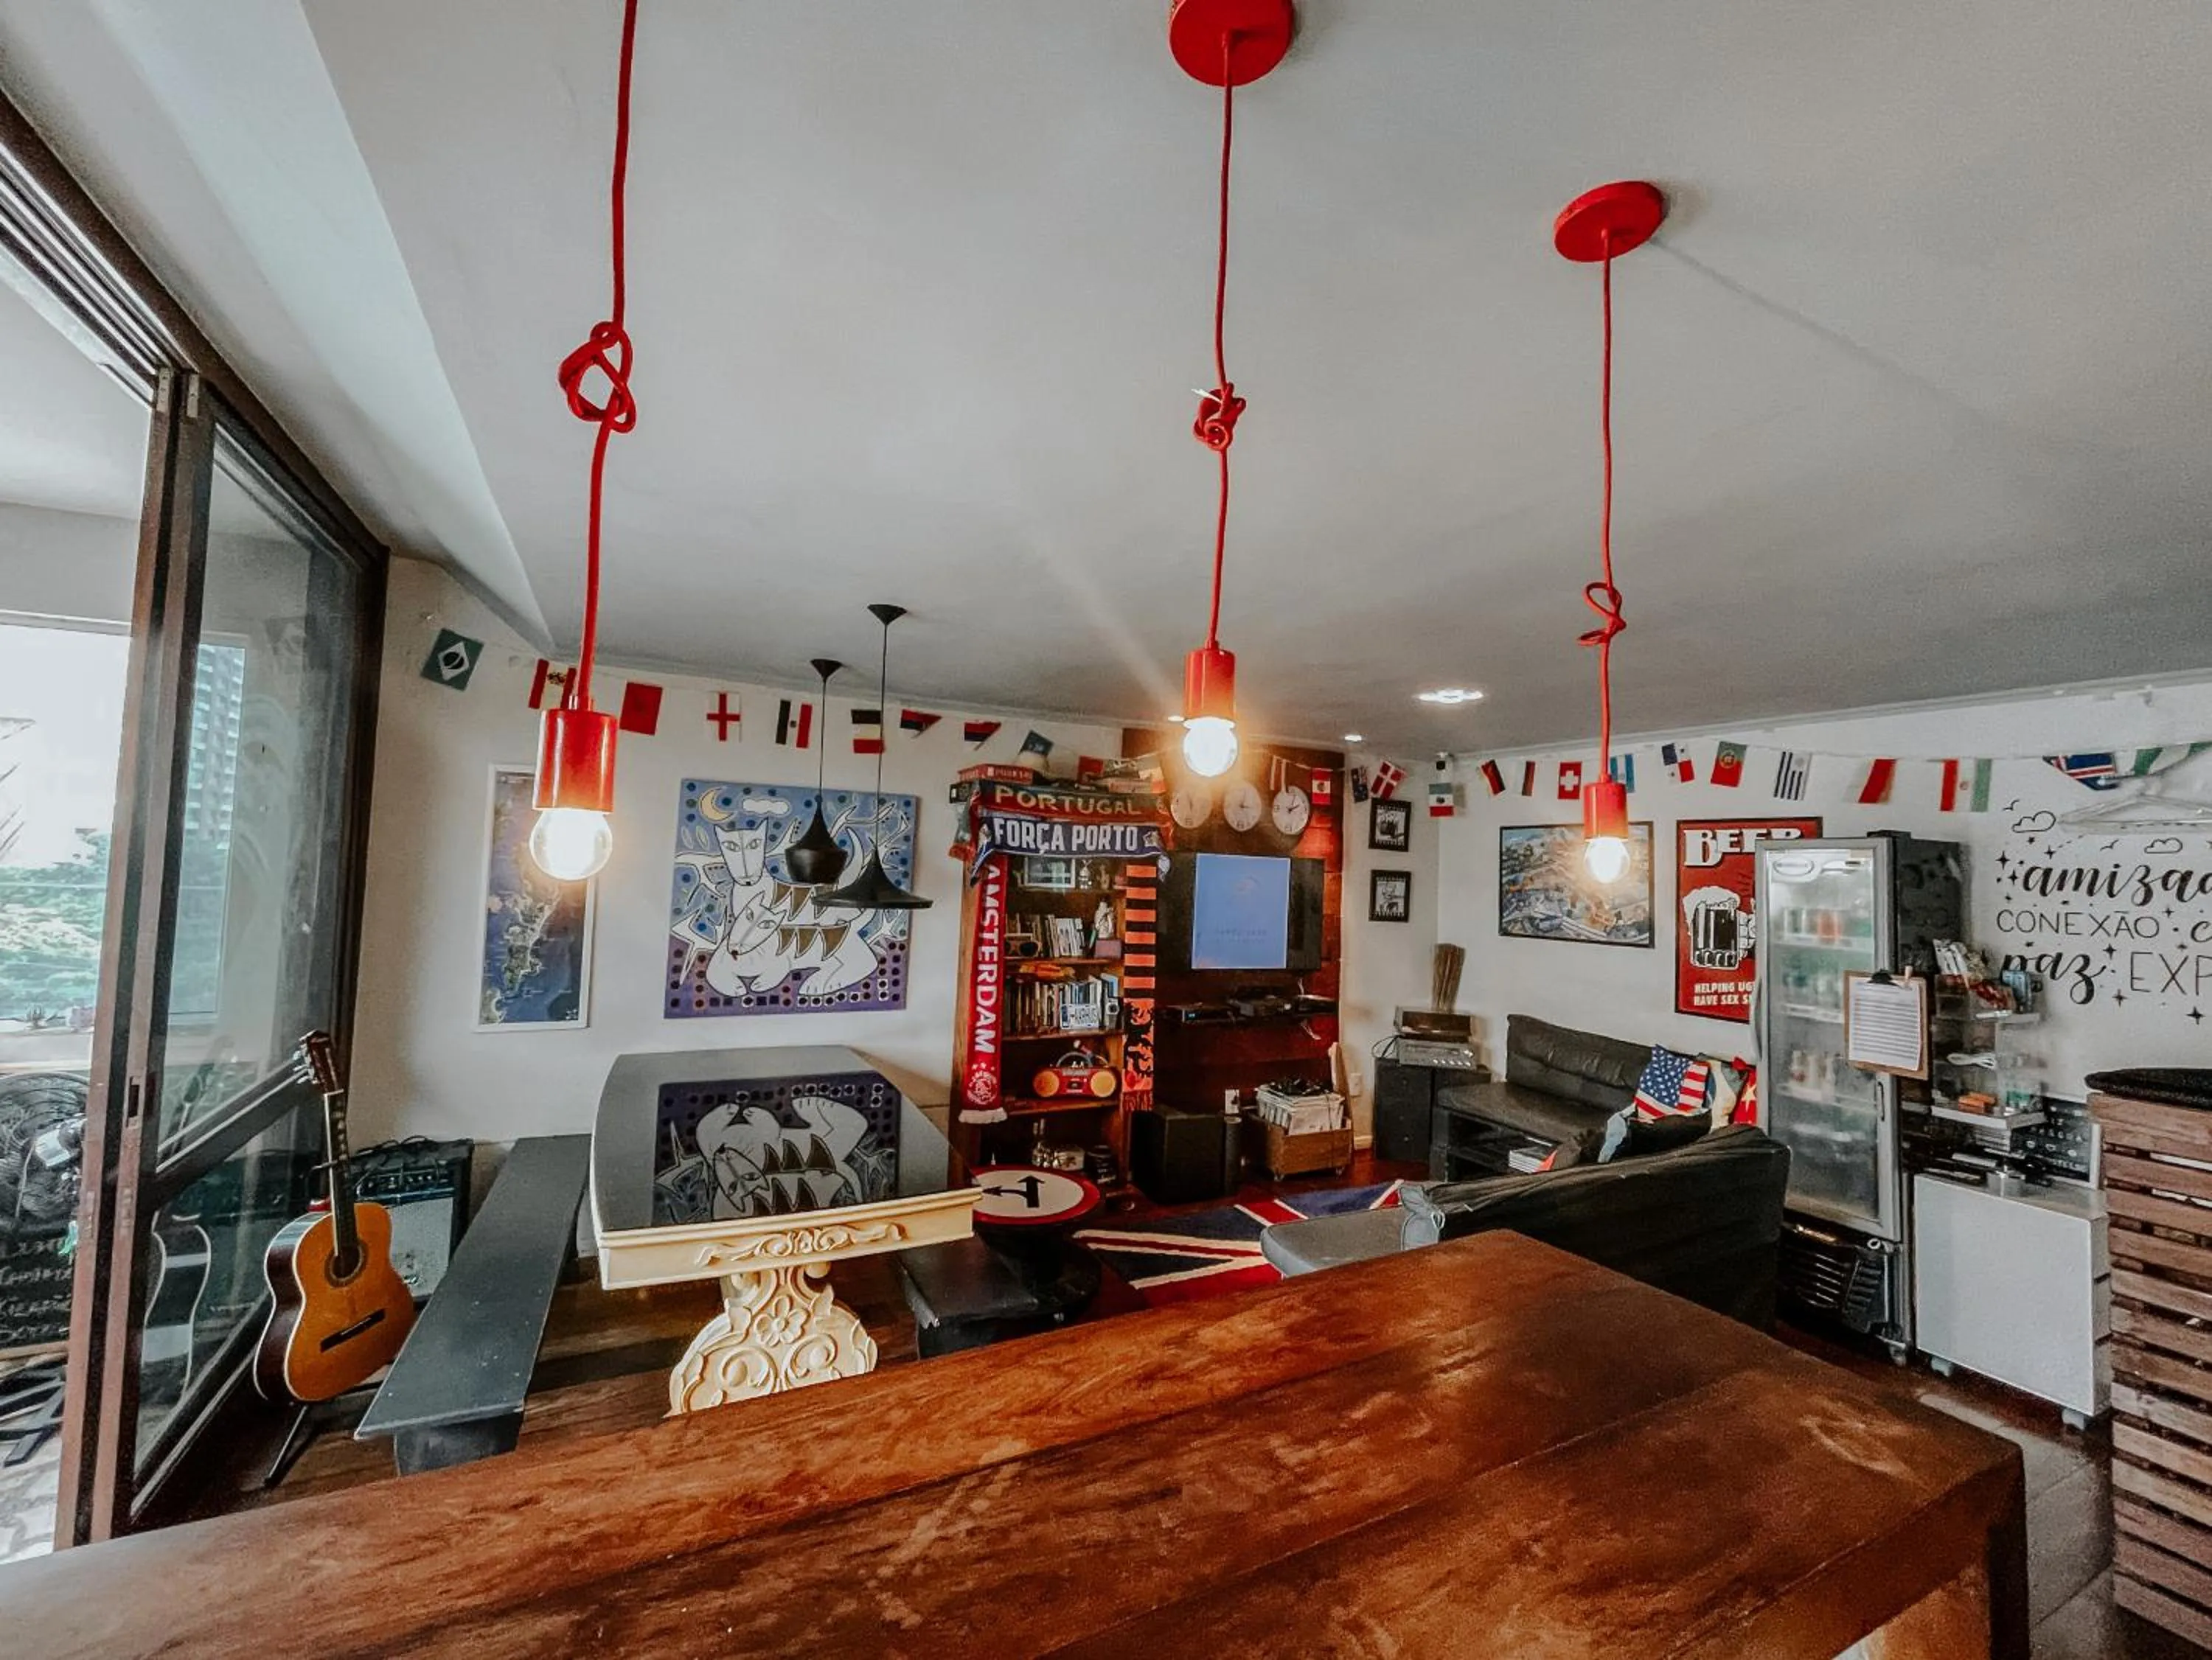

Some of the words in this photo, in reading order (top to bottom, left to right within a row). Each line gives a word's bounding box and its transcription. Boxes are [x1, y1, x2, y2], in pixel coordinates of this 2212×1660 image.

[995, 784, 1142, 815] PORTUGAL
[992, 817, 1065, 855] FORÇA
[1071, 825, 1138, 851] PORTO
[1996, 908, 2160, 940] CONEXÃO
[974, 864, 1001, 1054] AMSTERDAM
[1694, 982, 1735, 994] HELPING
[1694, 994, 1719, 1006] HAVE
[1720, 994, 1739, 1005] SEX
